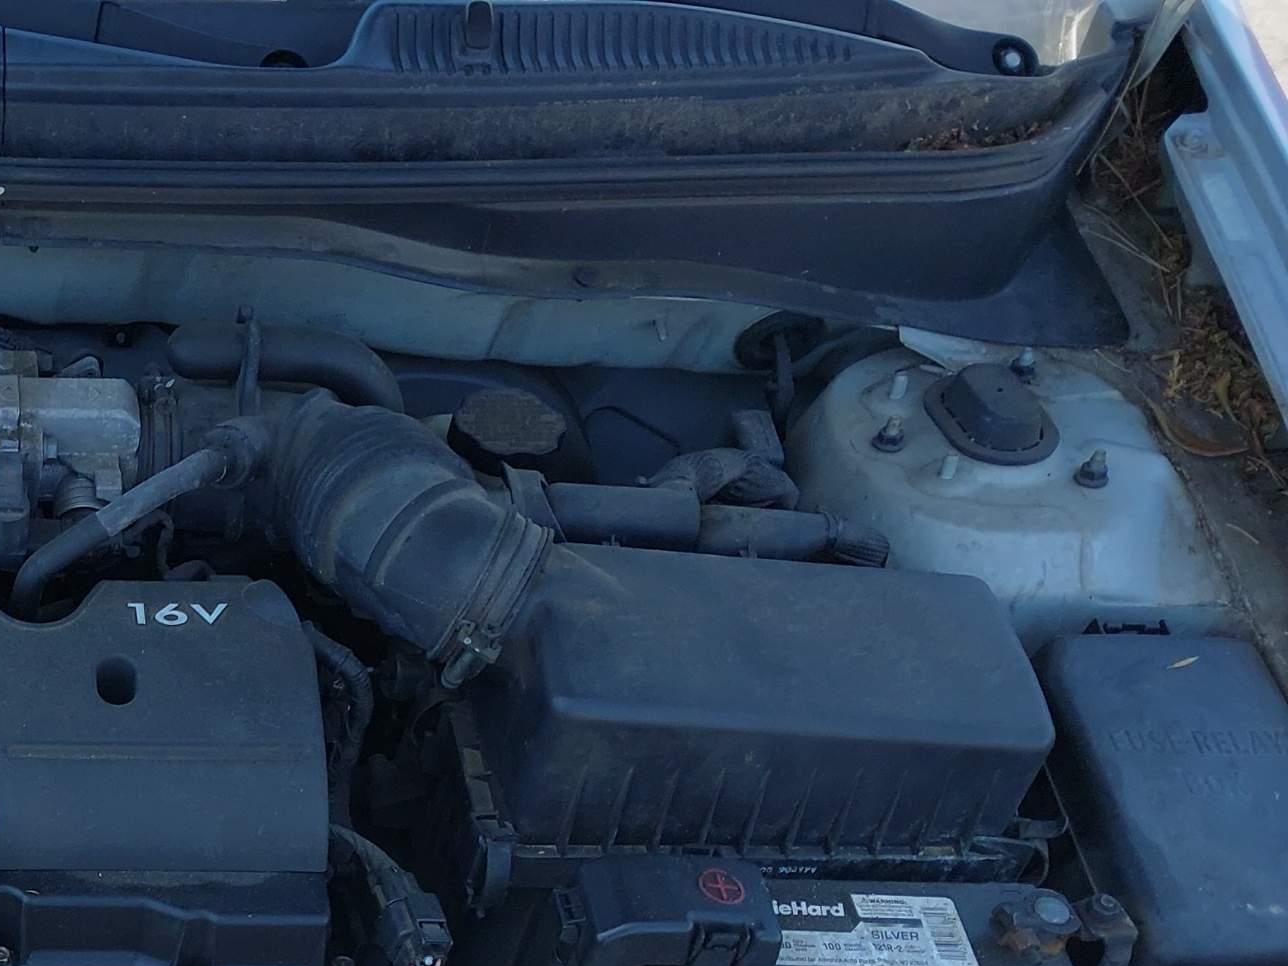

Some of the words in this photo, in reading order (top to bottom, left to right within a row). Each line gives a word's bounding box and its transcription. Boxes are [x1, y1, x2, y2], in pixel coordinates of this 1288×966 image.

[127, 602, 229, 627] 16V
[772, 901, 845, 917] ieHard
[871, 930, 920, 941] SILVER
[823, 942, 842, 951] 100
